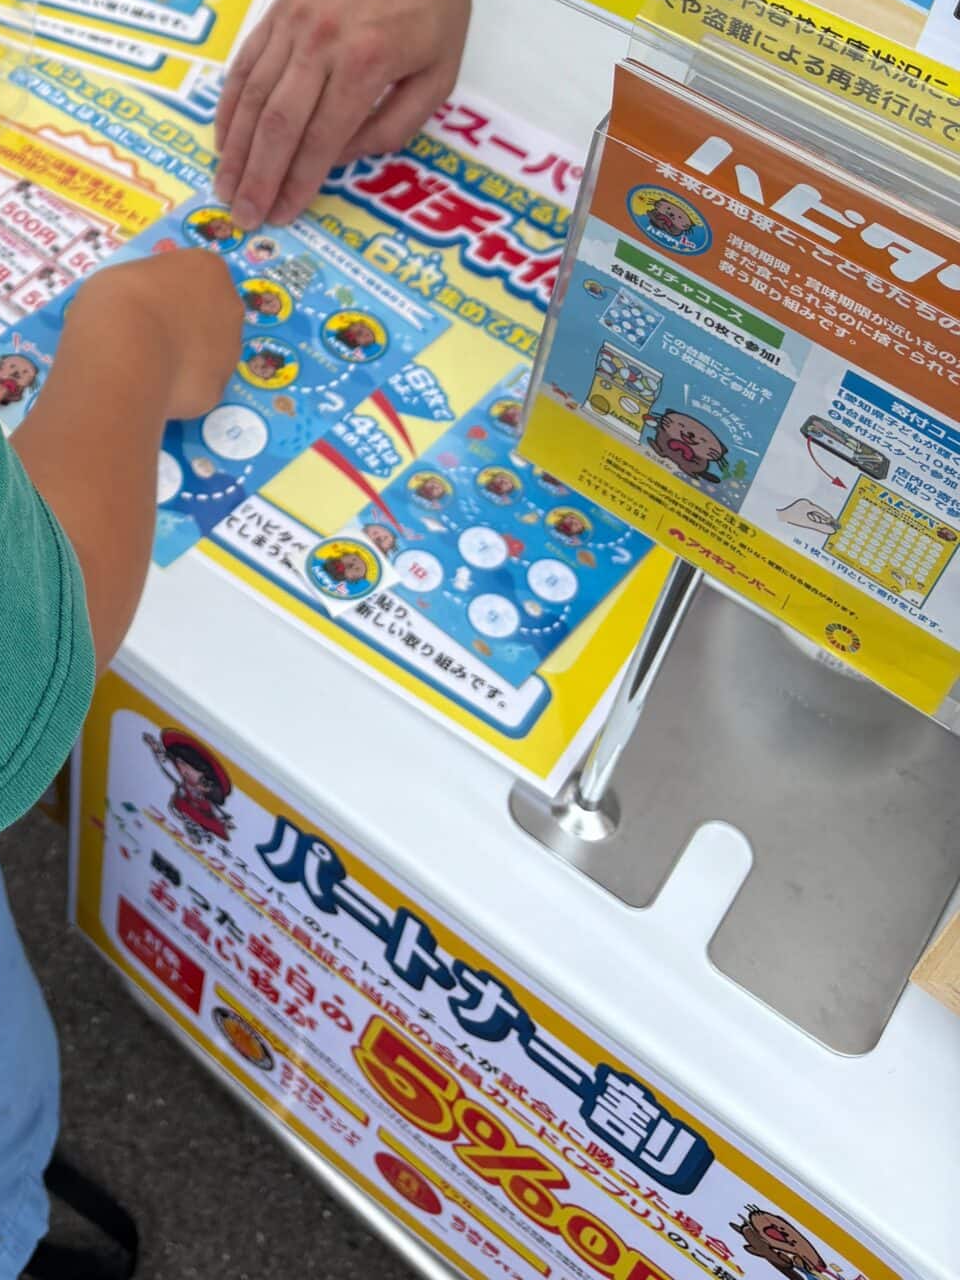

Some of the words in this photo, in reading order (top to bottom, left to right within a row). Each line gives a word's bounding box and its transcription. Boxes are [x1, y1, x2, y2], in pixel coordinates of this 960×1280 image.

[0, 195, 57, 246] 500円
[656, 163, 960, 335] 未来の地球と、こどもたちの
[610, 262, 781, 367] 台紙にシール10枚で参加!
[647, 262, 743, 323] ガチャコース
[719, 262, 857, 346] 救う取り組みです。
[725, 248, 960, 384] まだ食べられるのに捨てられて
[727, 233, 960, 369] 消費期限・賞味期限が近いもの
[662, 330, 773, 400] この台紙にシールを
[890, 401, 960, 446] 寄付コー
[686, 536, 778, 597] アオキスーパー
[355, 602, 507, 708] 新しい取り組みです。
[255, 816, 715, 1195] パートナー割り
